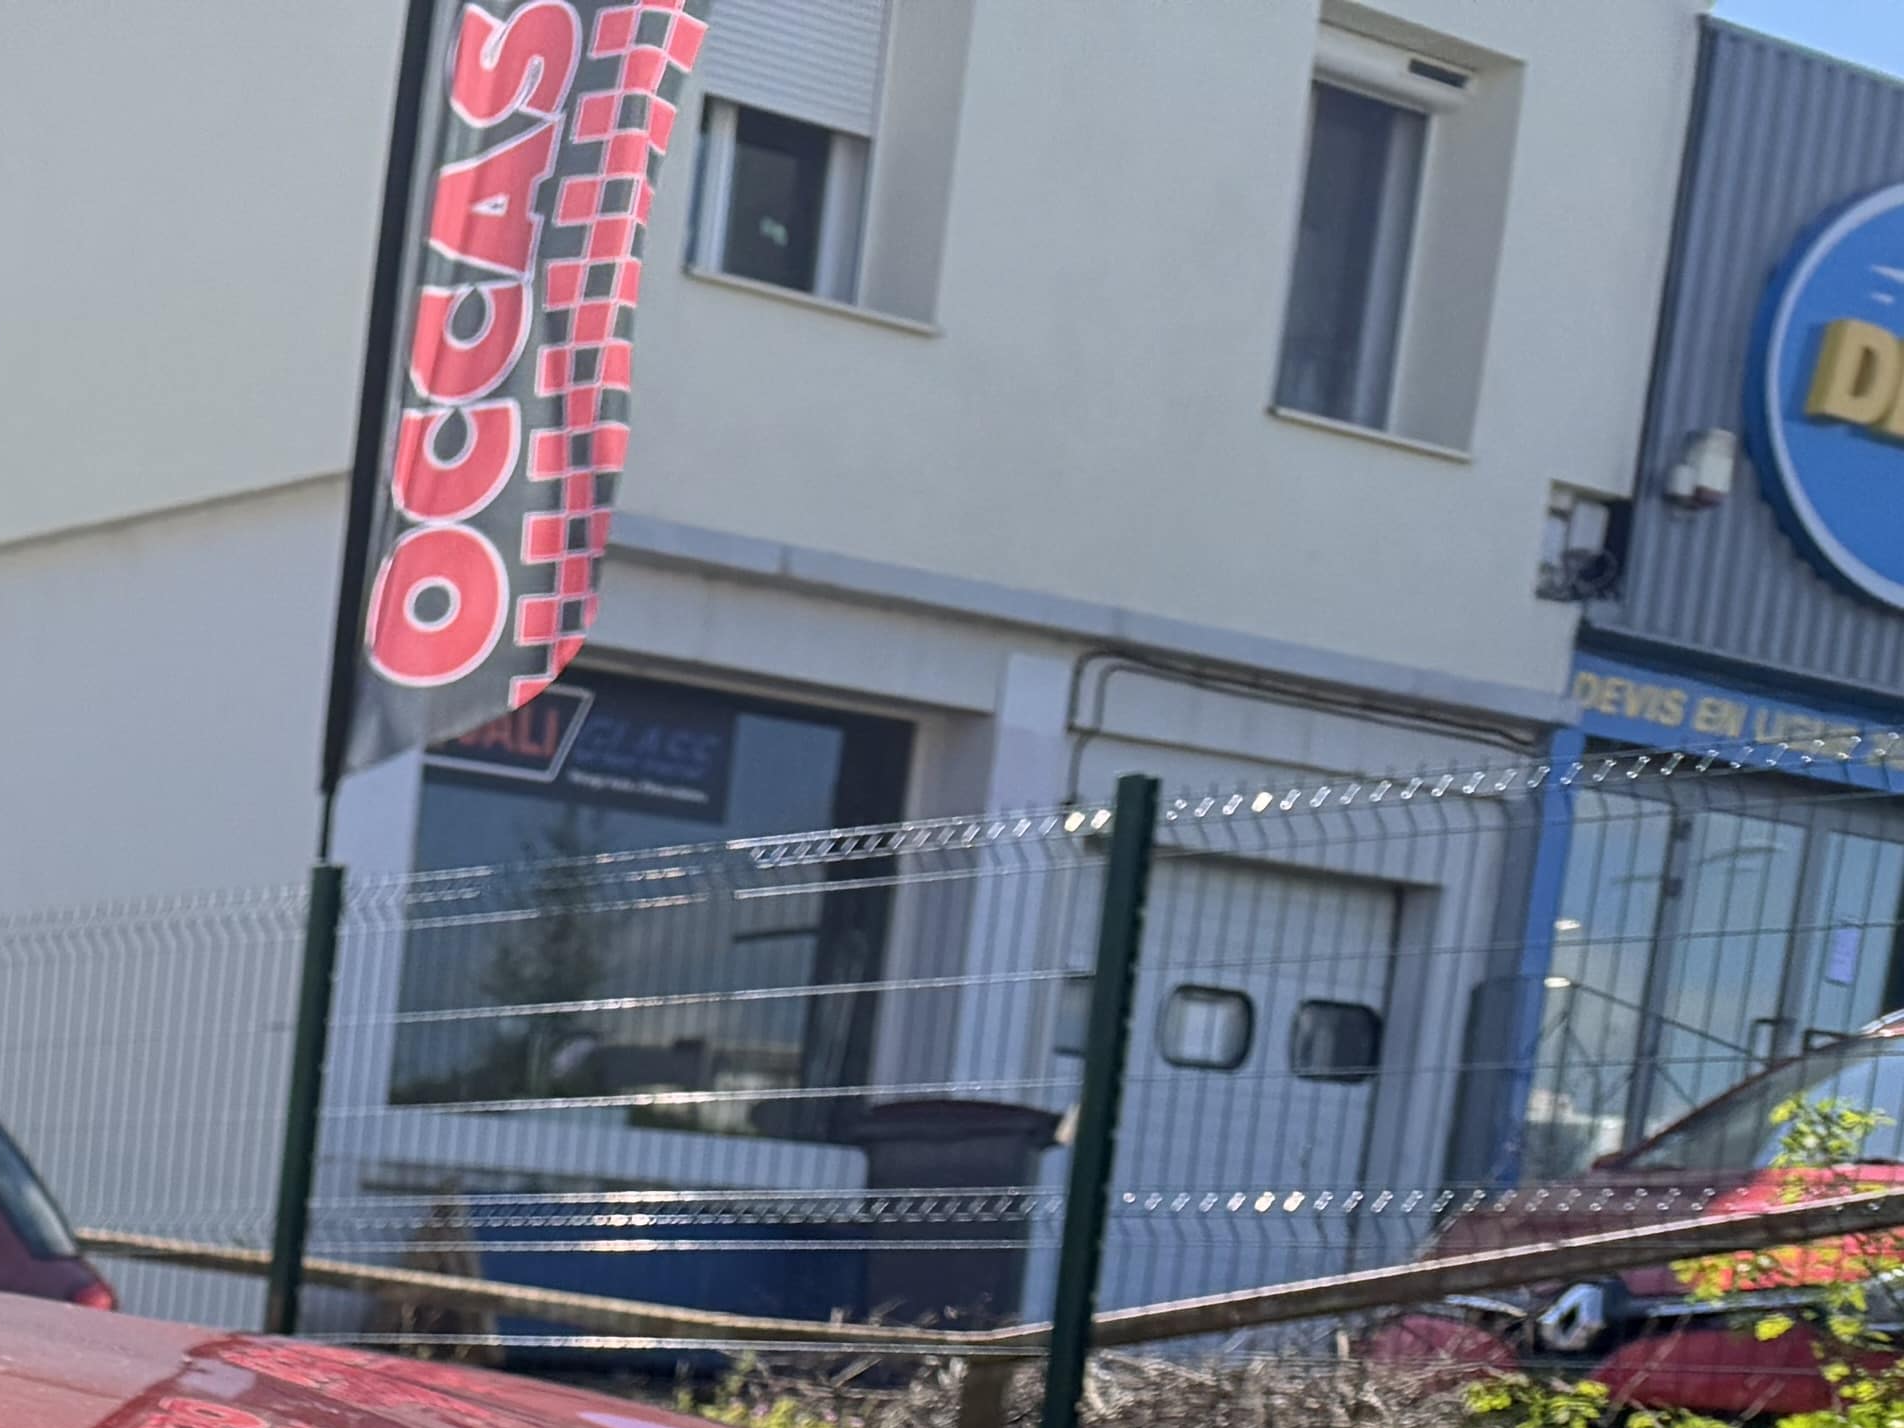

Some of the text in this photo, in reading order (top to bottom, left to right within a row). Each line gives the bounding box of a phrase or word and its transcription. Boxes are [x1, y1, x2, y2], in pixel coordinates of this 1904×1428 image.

[365, 0, 584, 688] OCCAS
[1804, 318, 1904, 440] D
[1572, 670, 1688, 728] DEVIS
[1691, 694, 1749, 739] EN
